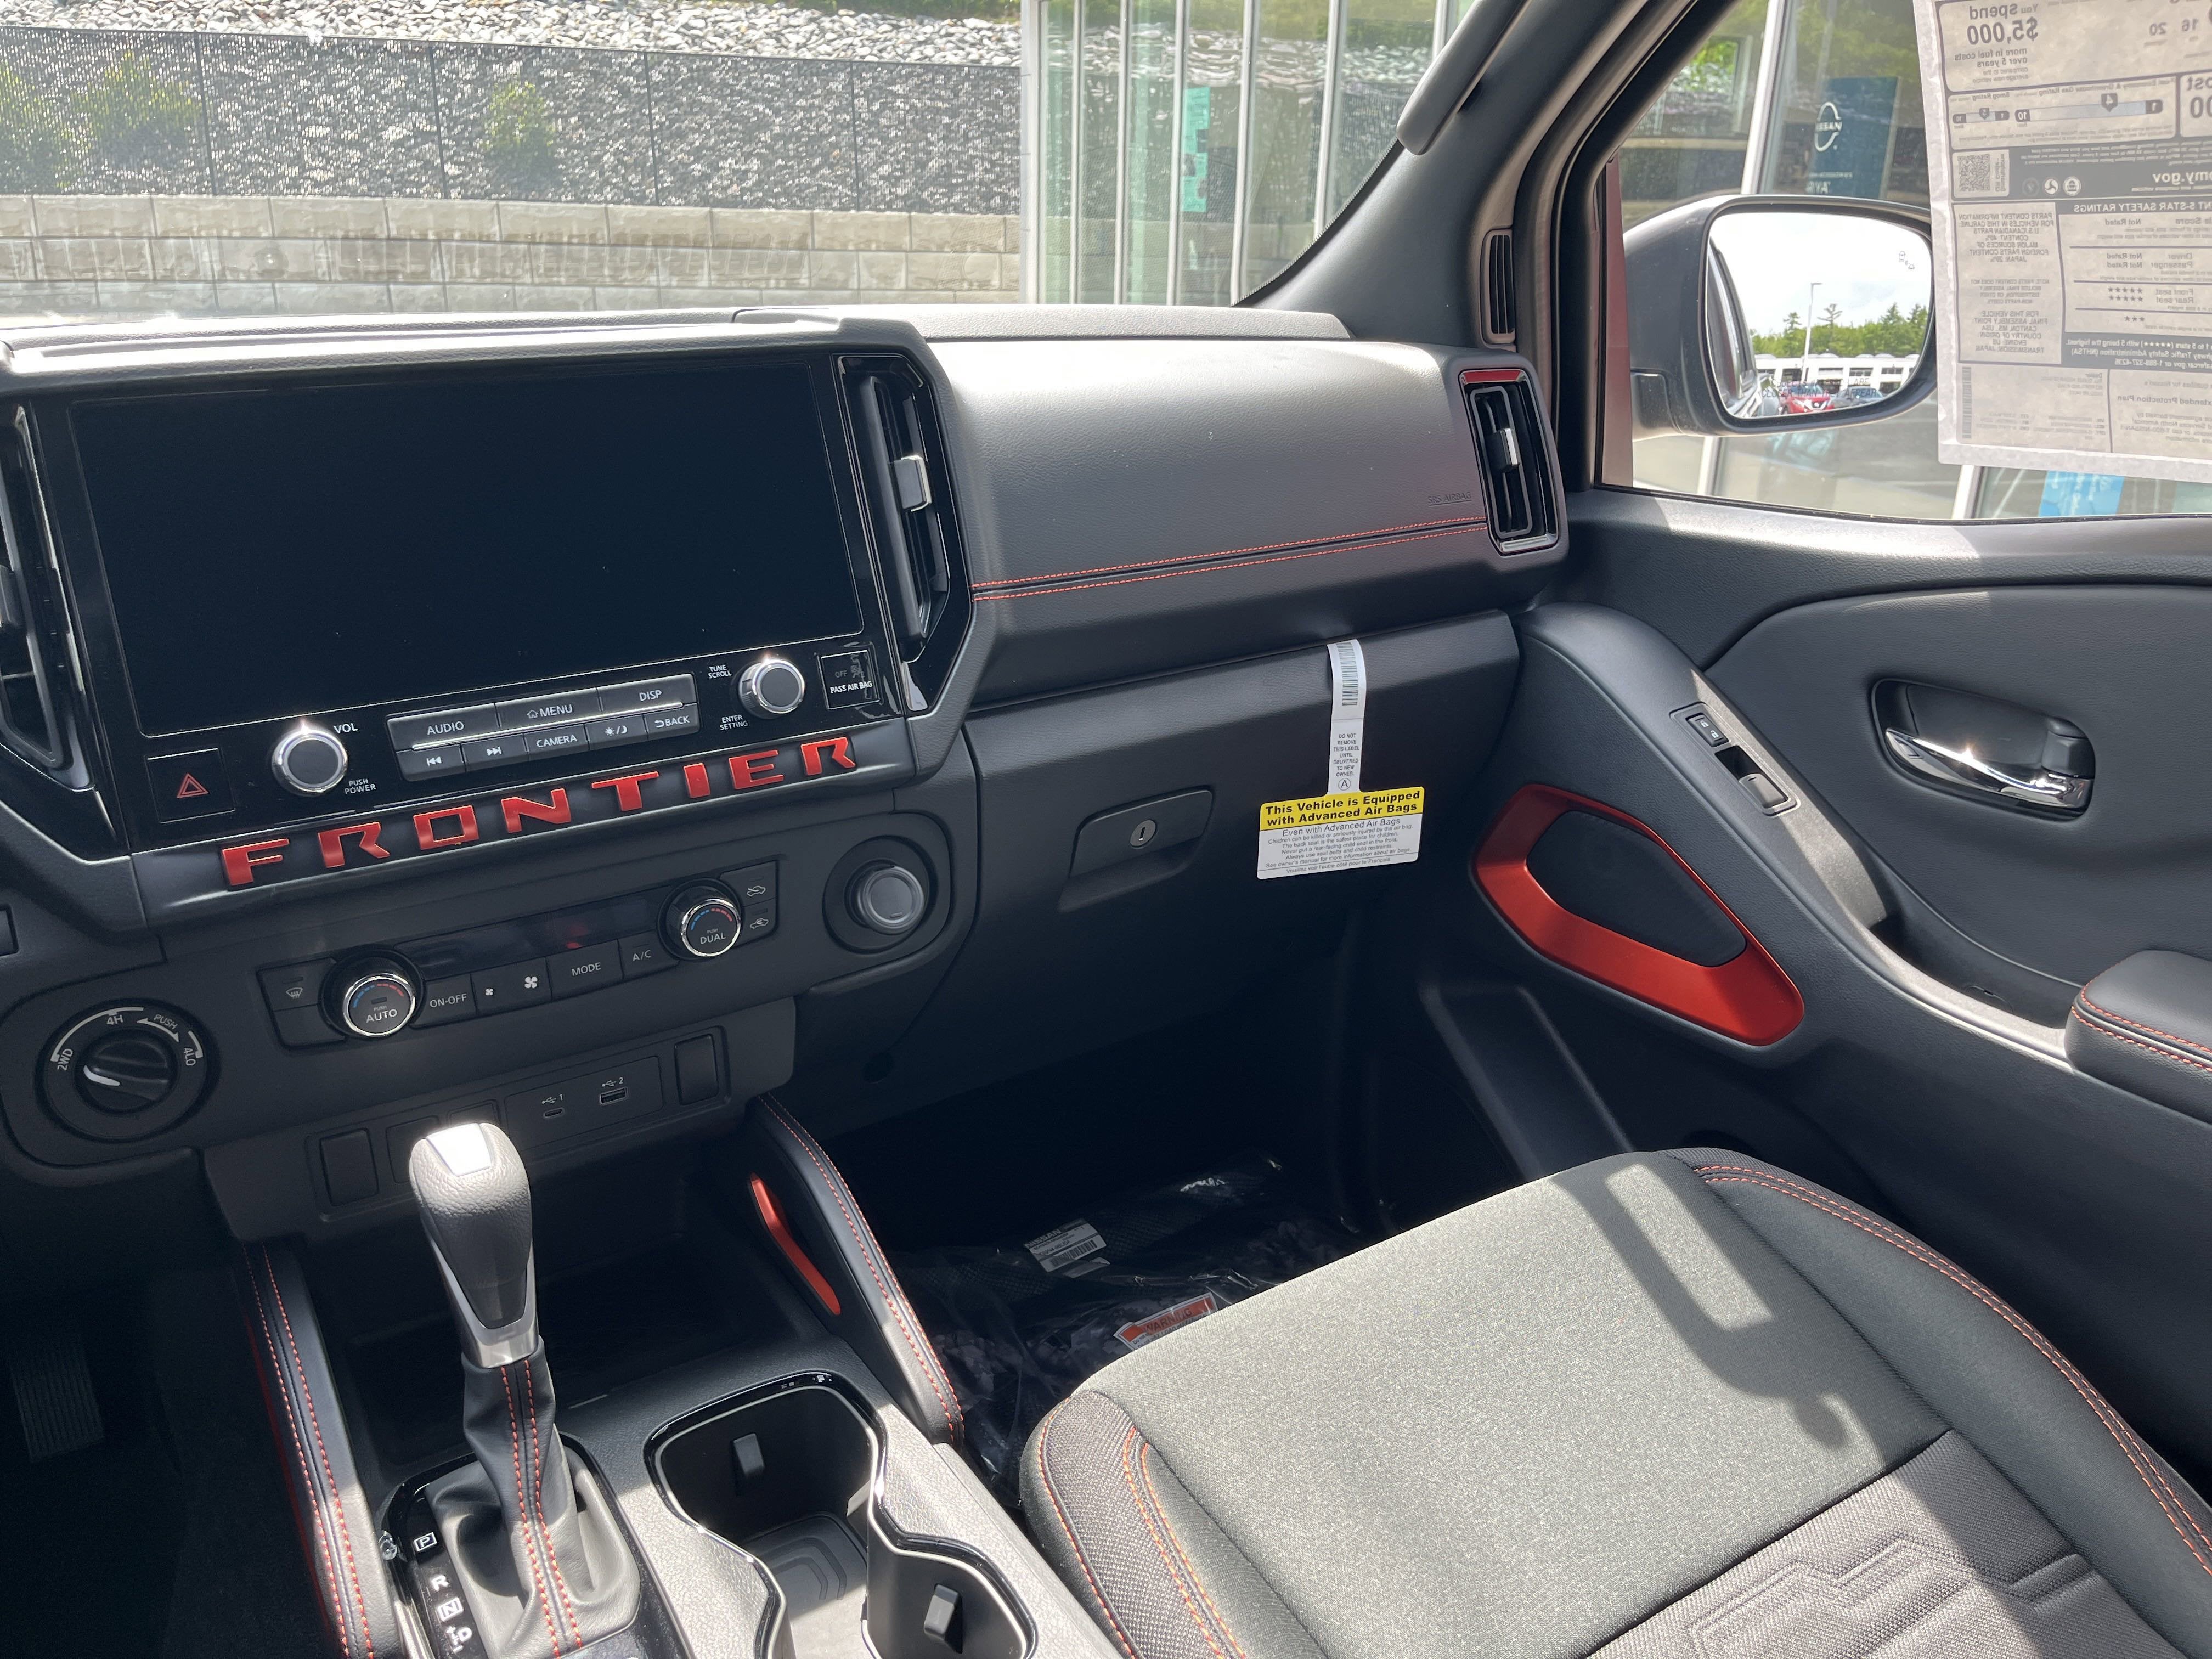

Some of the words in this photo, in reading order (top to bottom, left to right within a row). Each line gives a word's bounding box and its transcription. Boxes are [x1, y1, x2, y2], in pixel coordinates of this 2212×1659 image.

[1427, 495, 1441, 504] SRS
[1443, 492, 1472, 501] AIRBAG
[708, 670, 732, 679] SCROLL
[709, 664, 727, 673] TUNE
[830, 685, 847, 694] PASS
[848, 682, 859, 691] AIR
[859, 680, 873, 690] BAG
[639, 689, 663, 701] DISP
[539, 703, 573, 718] MENU
[665, 715, 689, 727] BACK
[720, 720, 748, 731] SETTING
[721, 714, 742, 723] ENTER
[333, 723, 358, 734] VOL
[427, 721, 465, 736] AUDIO
[536, 733, 578, 748] CAMERA
[345, 783, 376, 795] POWER
[1341, 780, 1348, 788] A
[1266, 805, 1293, 815] This
[1297, 799, 1344, 811] Vehicle
[1348, 798, 1358, 806] is
[1363, 791, 1420, 805] Equipped
[221, 736, 856, 886] FRONTIER
[1267, 816, 1294, 826] with
[1299, 808, 1360, 822] Advanced
[1364, 806, 1383, 815] Air
[1387, 804, 1417, 813] Bags
[1306, 826, 1322, 834] with
[1324, 821, 1364, 832] Advanced
[700, 932, 726, 944] DUAL
[632, 950, 652, 962] A/C
[571, 962, 602, 976] MODE
[106, 1014, 124, 1025] 4H
[154, 1014, 178, 1030] PUSH
[366, 1009, 398, 1023] AUTO
[57, 1048, 74, 1071] 2WD
[184, 1047, 196, 1066] 4LO
[1026, 1229, 1062, 1248] NISSAN
[419, 1536, 430, 1548] P
[432, 1575, 449, 1592] R
[442, 1601, 457, 1615] N
[458, 1627, 472, 1643] D
